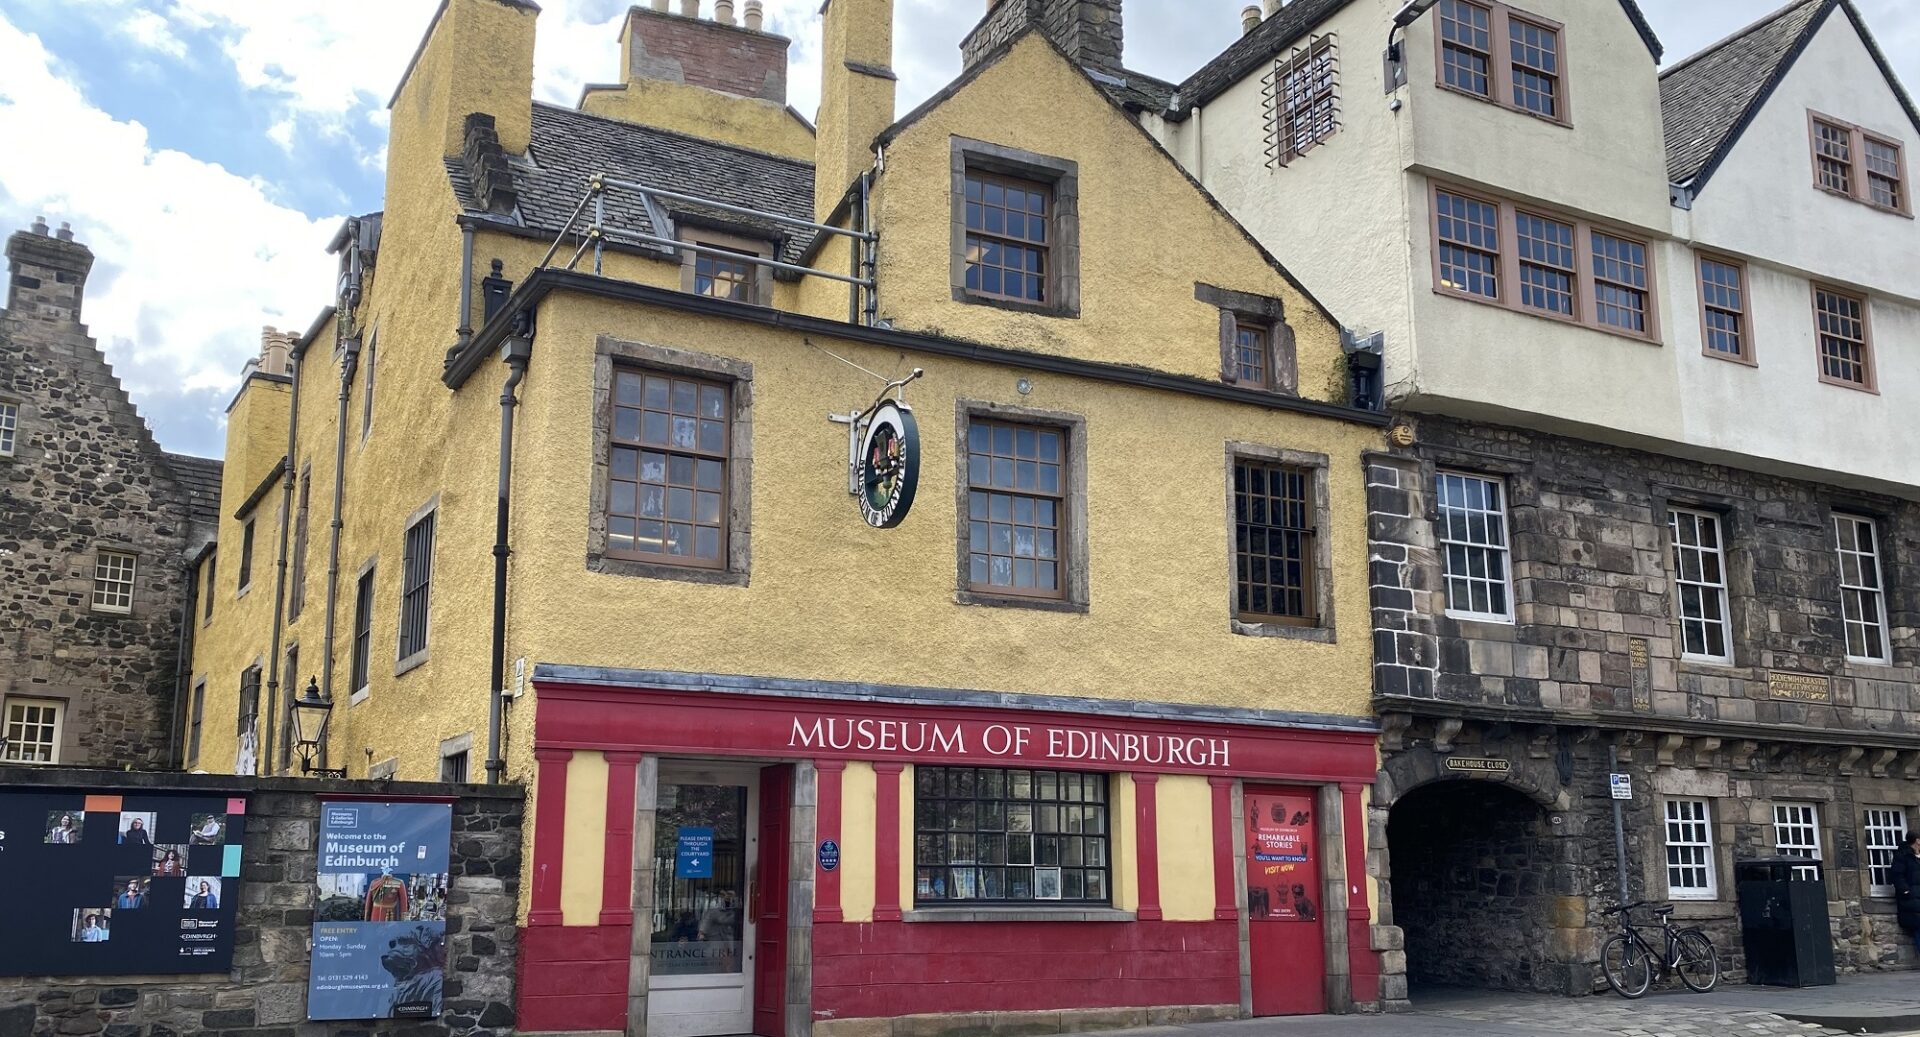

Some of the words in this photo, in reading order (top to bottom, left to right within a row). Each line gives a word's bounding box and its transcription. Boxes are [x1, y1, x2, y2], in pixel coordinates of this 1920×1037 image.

[787, 715, 968, 754] MUSEUM
[982, 725, 1031, 756] OF
[1046, 729, 1231, 767] EDINBURGH
[1450, 760, 1485, 768] BAKEHOUSE
[1258, 834, 1300, 842] REMARKABLE
[326, 842, 386, 853] Museum
[389, 842, 406, 853] of
[324, 855, 399, 869] Edinburgh
[1264, 866, 1280, 875] VISIT
[1280, 864, 1295, 872] NOW
